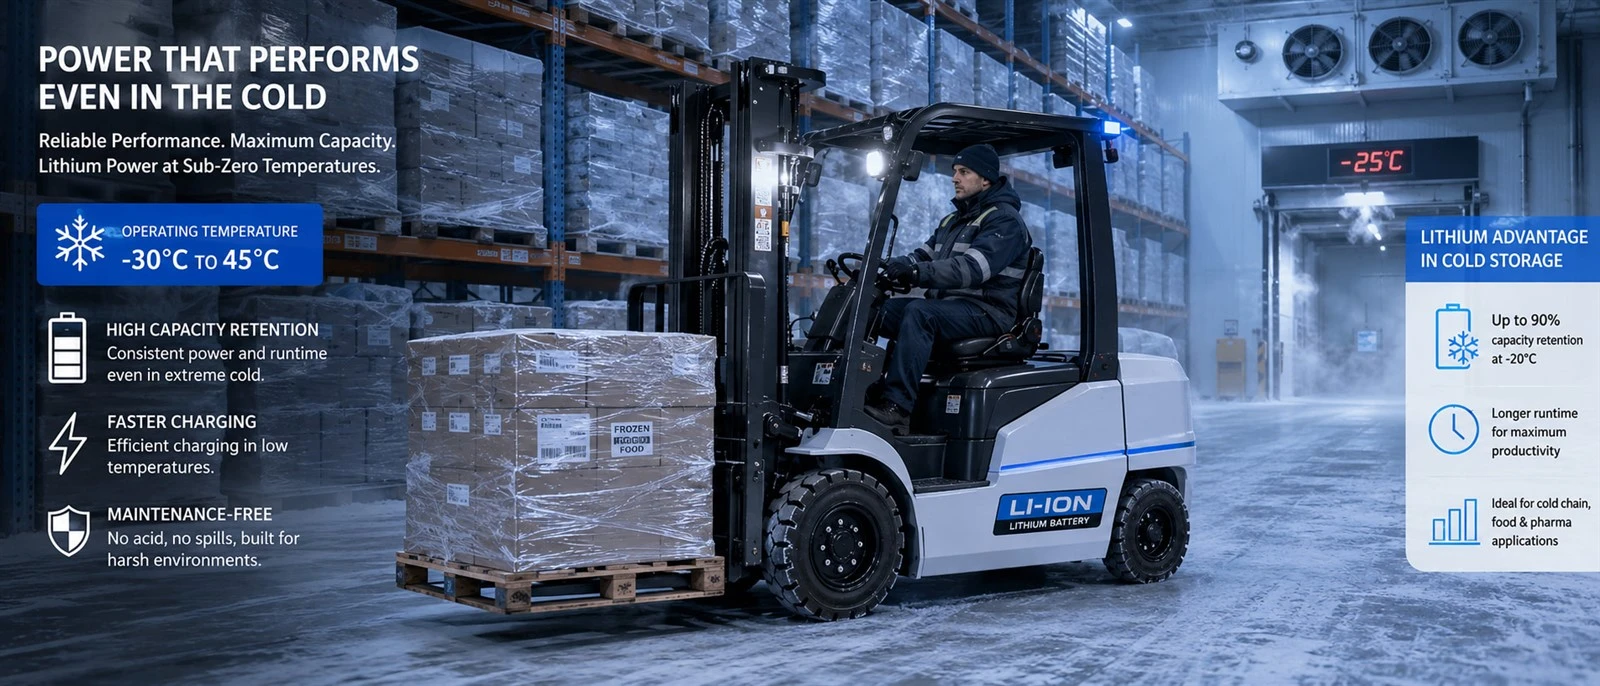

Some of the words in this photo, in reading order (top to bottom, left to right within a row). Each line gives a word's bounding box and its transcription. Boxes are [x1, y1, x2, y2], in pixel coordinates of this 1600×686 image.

[1341, 150, 1403, 172] -25°C
[614, 425, 650, 433] FROZEN
[620, 445, 644, 453] FOOD
[1009, 494, 1092, 516] LI-ION
[1009, 520, 1047, 531] LITHIUM
[1050, 517, 1091, 527] BATTERY
